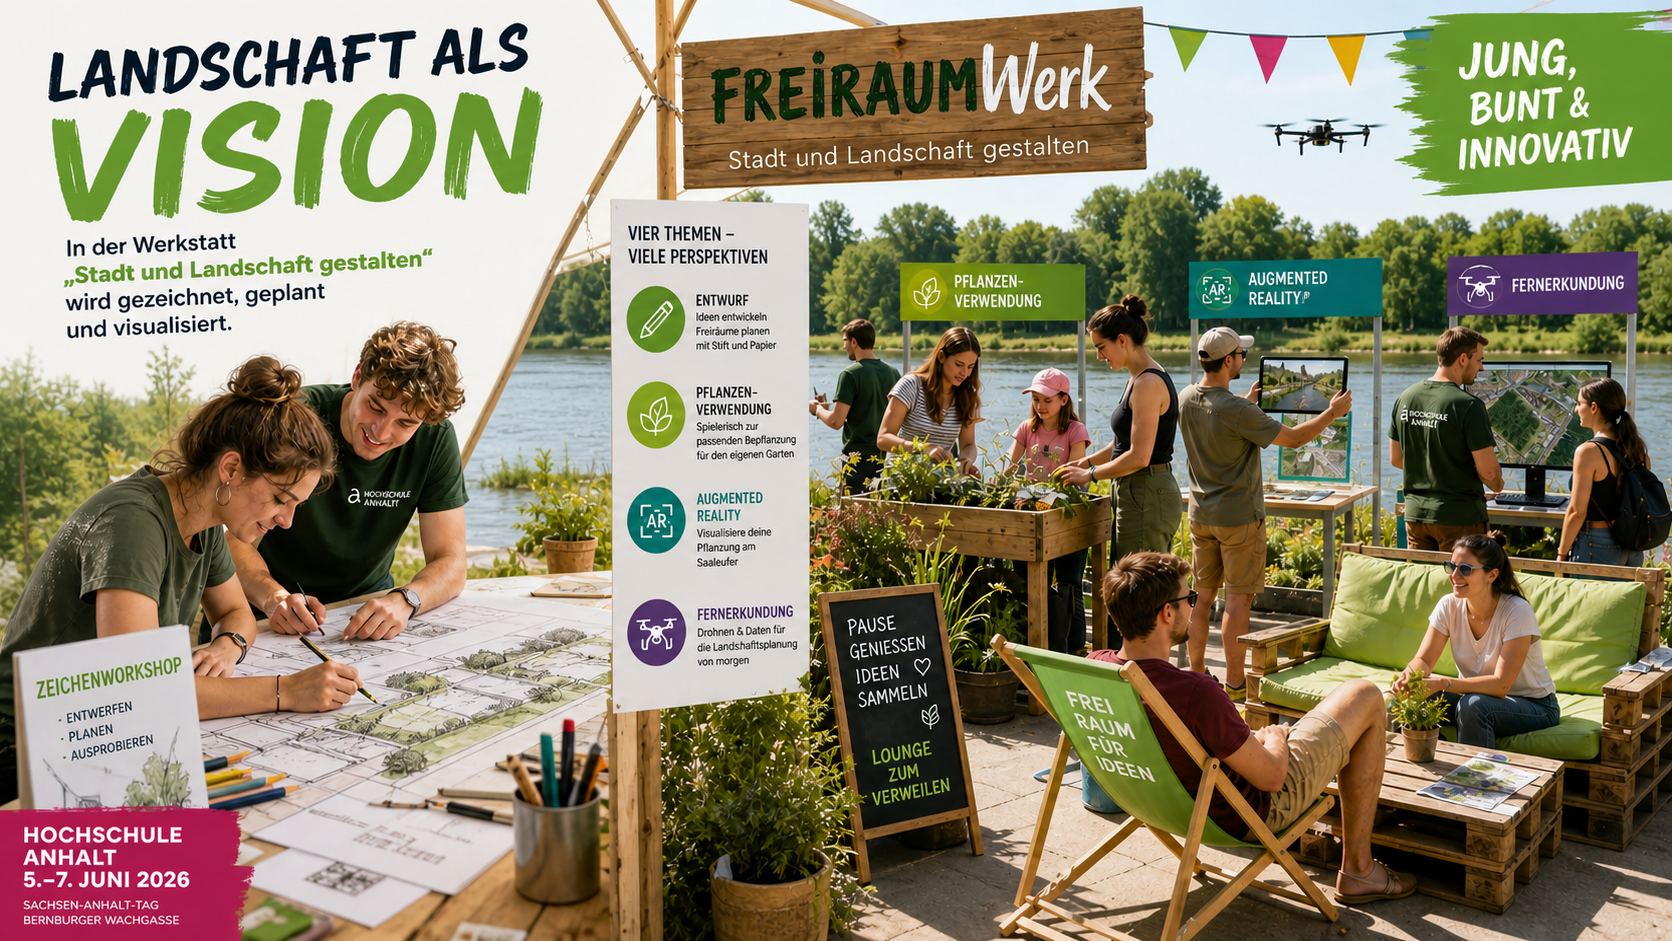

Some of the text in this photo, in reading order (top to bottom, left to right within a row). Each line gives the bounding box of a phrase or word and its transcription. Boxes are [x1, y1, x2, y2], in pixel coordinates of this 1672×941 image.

[728, 134, 1090, 171] Stadt und Landschaft gestalten
[628, 225, 660, 241] VIER
[663, 226, 722, 241] THEMEN
[628, 248, 768, 265] VIELE PERSPEKTIVEN
[954, 274, 1024, 289] PFLANZEN-
[1248, 271, 1328, 286] AUGMENTED
[1512, 275, 1625, 293] FERNERKUNDUNG
[1209, 283, 1226, 296] AR
[695, 294, 749, 307] ENTWURF
[954, 294, 1042, 308] VERWENDUNG
[1248, 291, 1302, 306] REALITY
[695, 312, 767, 322] Ideen entwickeln
[741, 326, 770, 338] planen
[695, 340, 777, 352] mit Stift und Papier
[696, 386, 758, 399] PFLANZEN-
[696, 403, 772, 416] VERWENDUNG
[696, 421, 759, 433] Spielerisch zur
[696, 434, 797, 448] passenden Bepflanzung
[696, 449, 795, 461] für den eigenen Garten
[696, 492, 763, 506] AUGMENTED
[646, 513, 667, 528] AR
[697, 509, 741, 522] REALITY
[696, 527, 772, 538] Visualisiere deine
[697, 542, 756, 554] Pflanzung am
[696, 557, 739, 568] Saaleufer
[697, 605, 794, 621] FERNERKUNDUNG
[697, 624, 786, 638] Drohnen & Daten für
[847, 614, 897, 637] PAUSE
[697, 643, 711, 652] die
[849, 635, 926, 661] GENIESSEN
[697, 657, 750, 667] von morgen
[36, 656, 182, 700] ZEICHENWORKSHOP
[855, 664, 900, 685] IDEEN
[858, 682, 928, 708] SAMMELN
[1065, 690, 1114, 715] FREI
[66, 701, 133, 724] ENTWERFEN
[68, 723, 114, 743] PLANEN
[1074, 712, 1136, 740] RAUM
[70, 734, 154, 761] AUSPROBIEREN
[871, 740, 932, 766] LOUNGE
[1087, 735, 1129, 758] FÜR
[888, 763, 920, 783] ZUM
[1095, 755, 1156, 782] IDEEN
[871, 777, 951, 806] VERWEILEN
